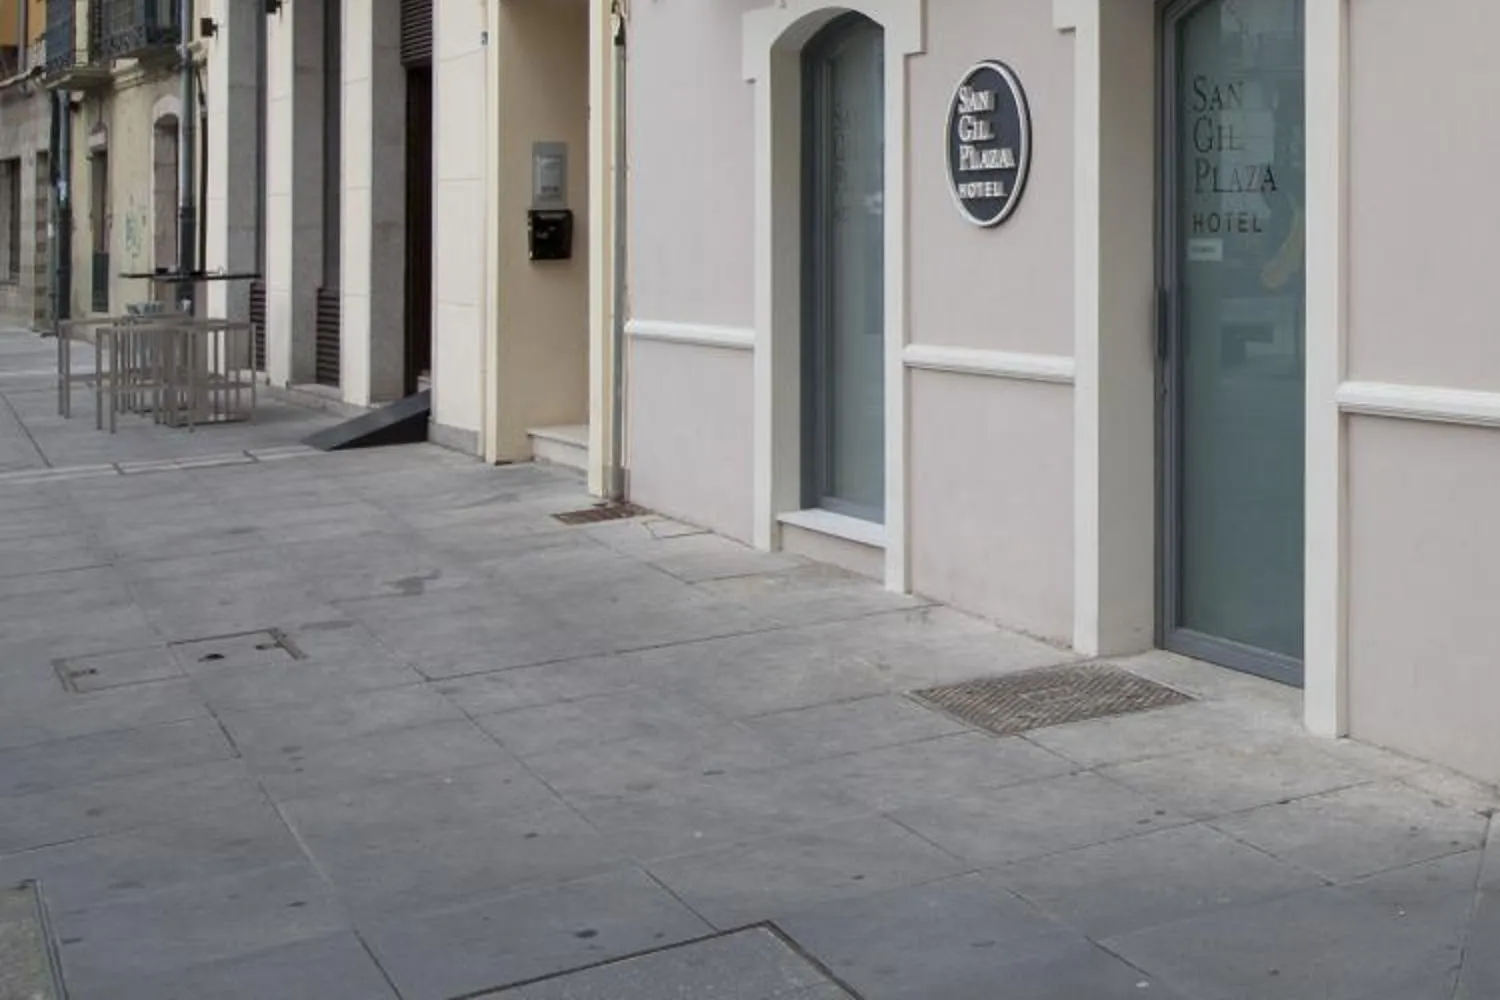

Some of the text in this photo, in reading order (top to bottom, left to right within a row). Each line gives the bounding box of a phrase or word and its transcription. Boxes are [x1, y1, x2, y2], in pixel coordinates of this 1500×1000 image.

[958, 86, 996, 113] SAN
[1193, 74, 1244, 113] SAN
[958, 115, 995, 142] GIL
[1193, 116, 1244, 153] GIL
[959, 143, 1016, 171] PLAZA
[1194, 158, 1278, 194] PLAZA
[958, 181, 1008, 199] HOTEL
[1193, 212, 1263, 234] HOTEL
